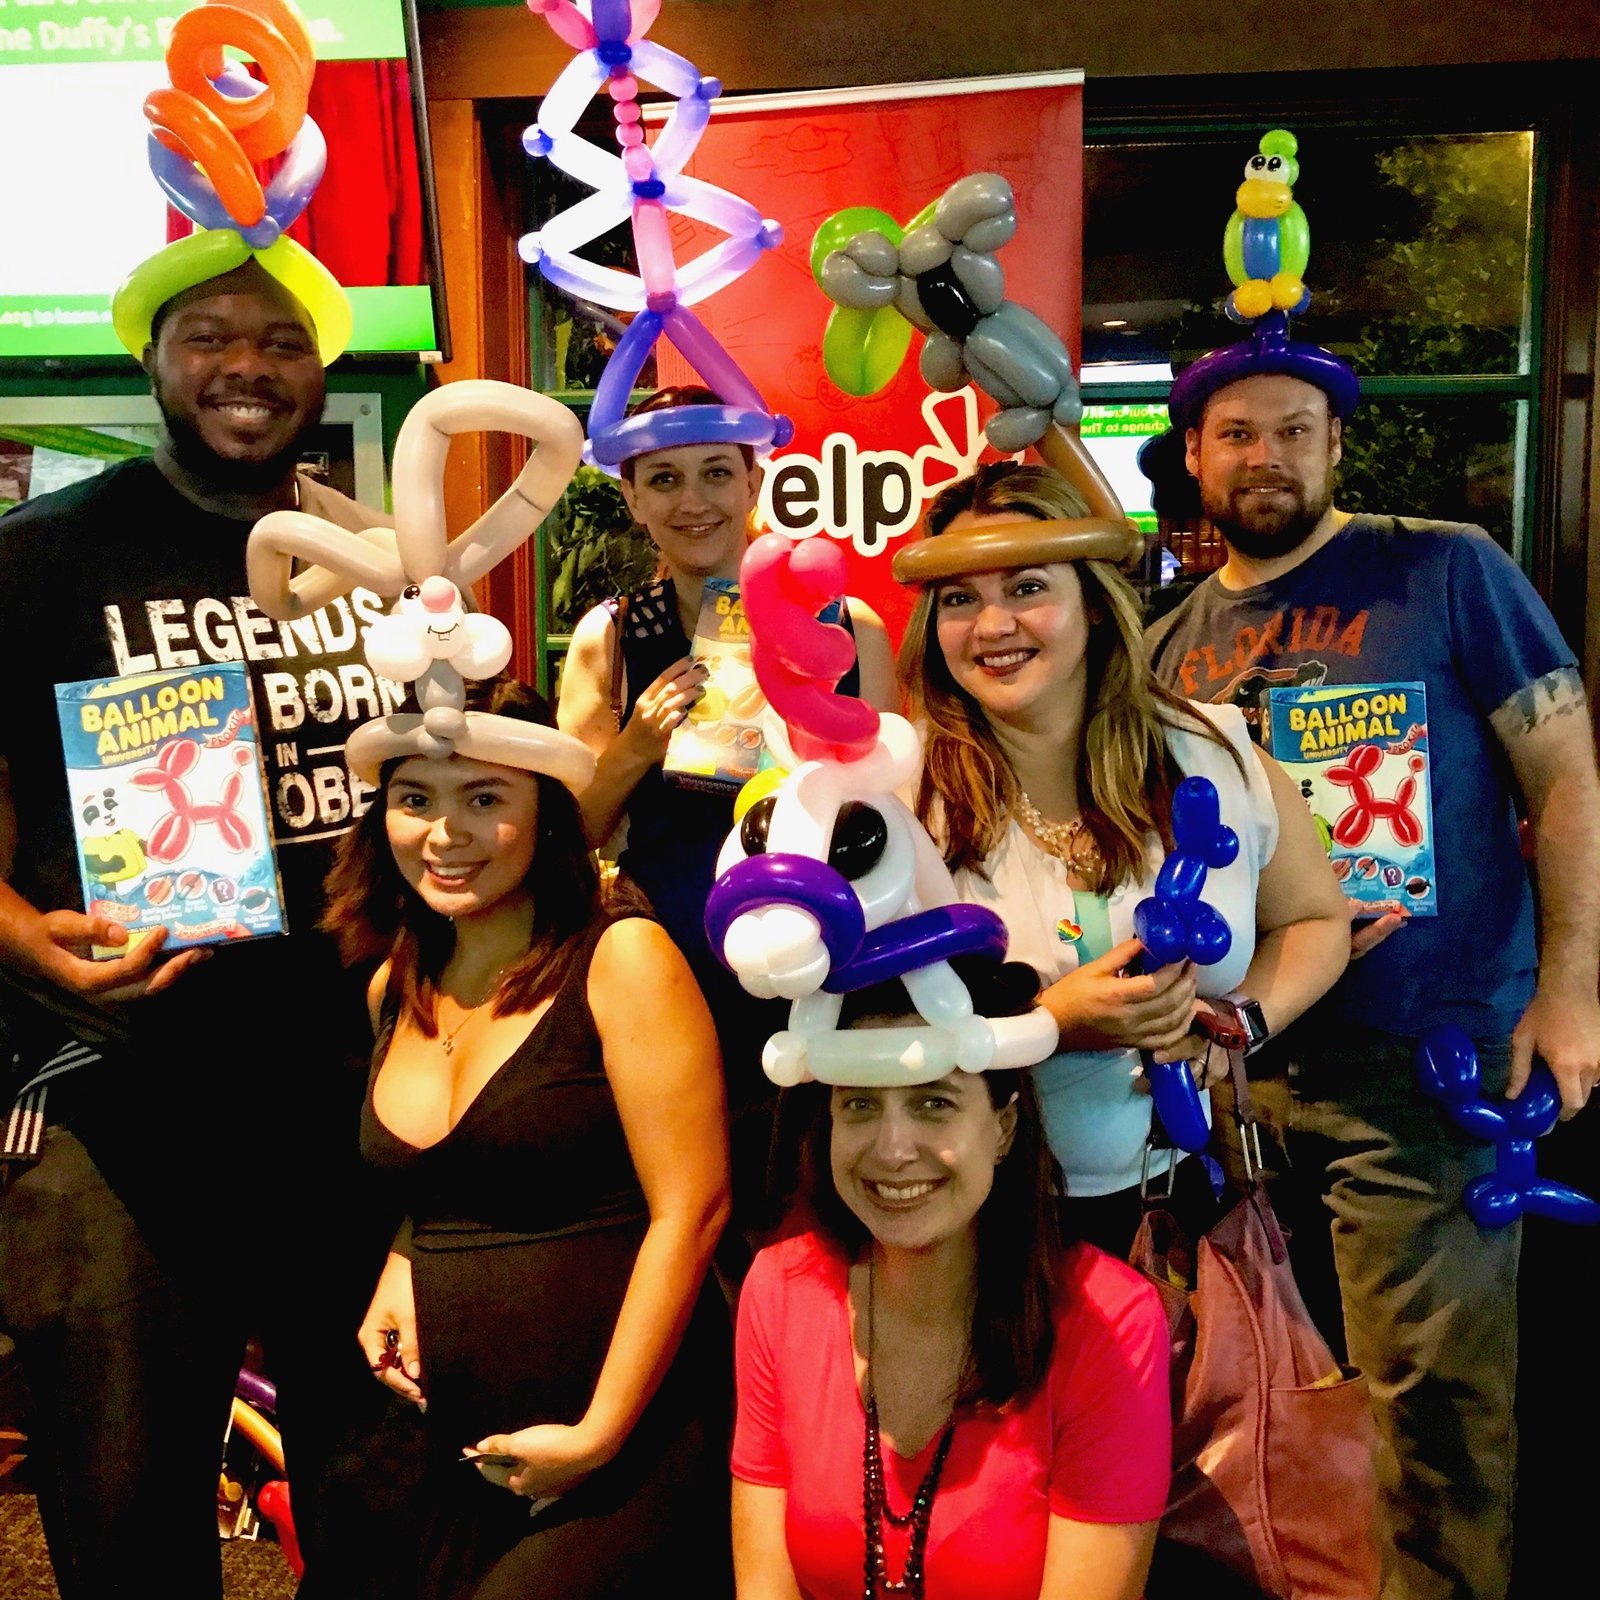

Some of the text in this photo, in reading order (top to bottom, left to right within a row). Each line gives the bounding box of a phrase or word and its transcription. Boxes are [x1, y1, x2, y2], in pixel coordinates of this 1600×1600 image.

[39, 16, 151, 55] Duffy's
[772, 443, 912, 546] elp
[103, 586, 385, 676] LEGENDS
[1178, 604, 1370, 696] FLORIDA
[80, 675, 225, 733] BALLOON
[262, 663, 407, 731] BORN
[1289, 693, 1407, 731] BALLOON
[97, 702, 219, 756] ANIMAL
[1300, 715, 1400, 752] ANIMAL
[102, 743, 158, 765] UNIVERSITY
[275, 742, 299, 767] IN
[1303, 745, 1350, 760] UNIVERSITY
